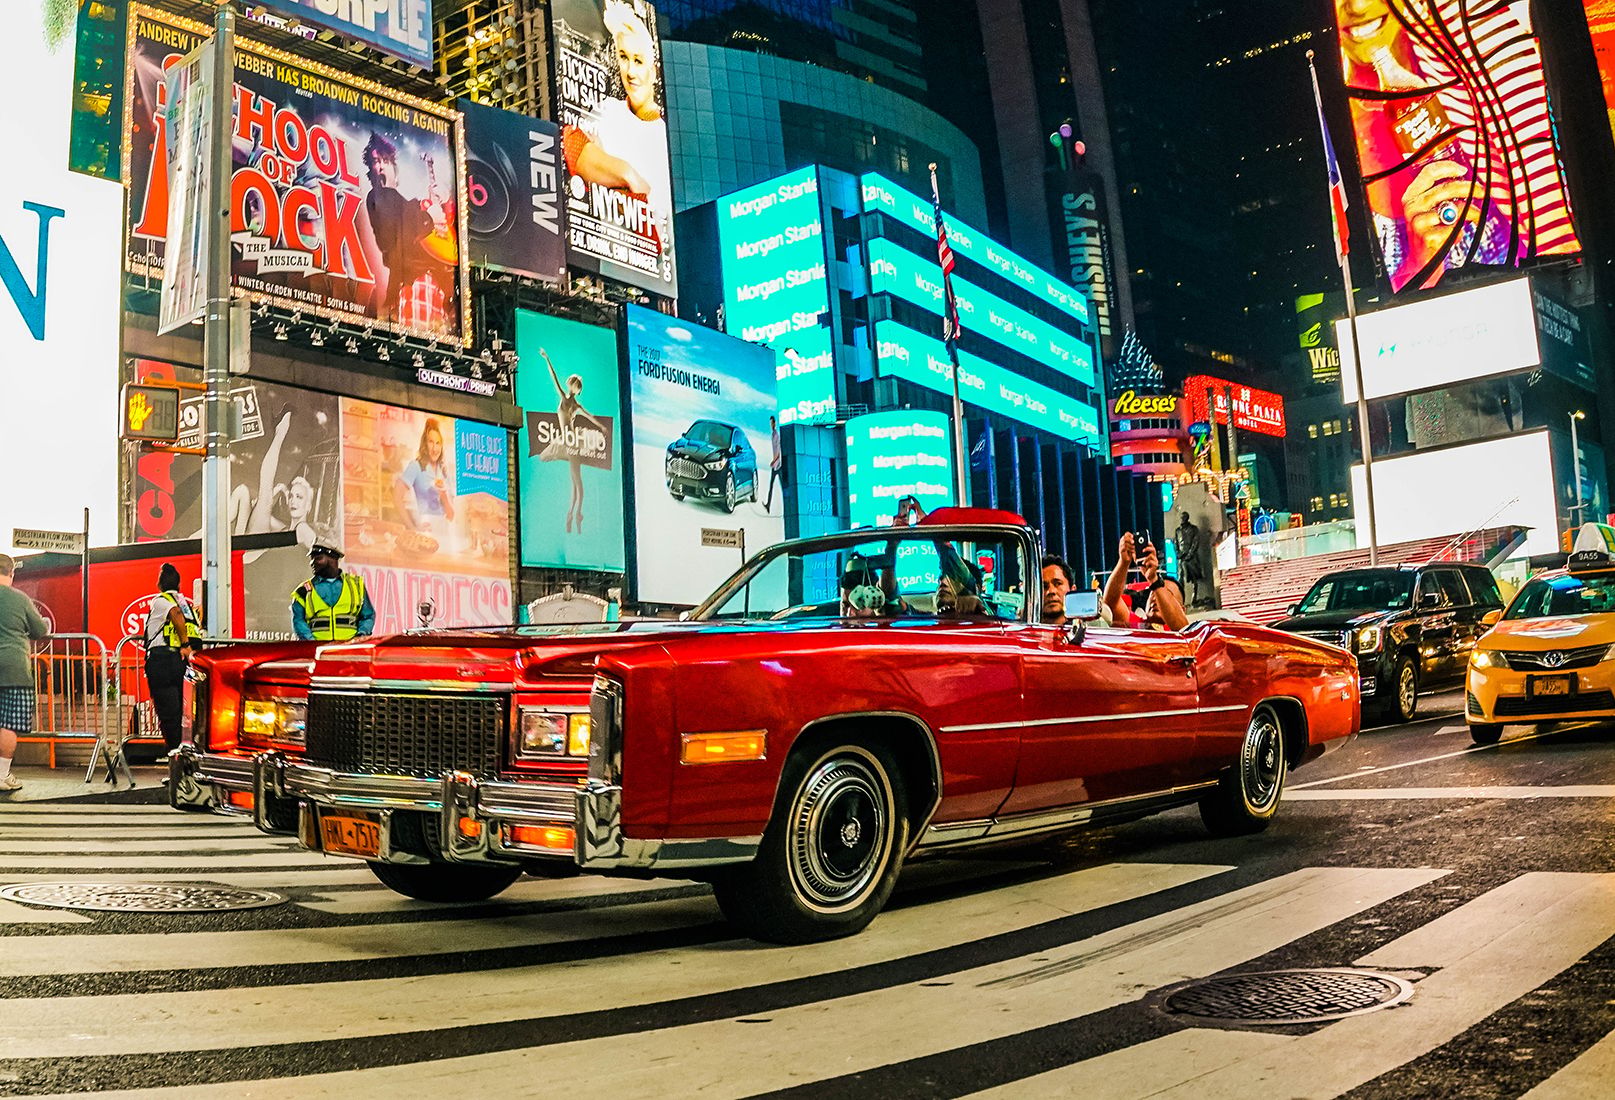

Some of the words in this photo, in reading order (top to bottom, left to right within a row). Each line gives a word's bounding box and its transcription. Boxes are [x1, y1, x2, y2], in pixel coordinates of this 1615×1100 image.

[138, 20, 188, 51] ANDREW
[560, 50, 606, 93] TICKETS
[277, 66, 300, 88] HAS
[302, 75, 360, 107] BROADWAY
[362, 95, 410, 124] ROCKING
[412, 112, 450, 136] AGAIN!
[562, 76, 579, 103] ON
[260, 152, 295, 187] OF
[528, 130, 559, 235] NEW
[730, 192, 777, 219] Morgan
[246, 243, 267, 253] THE
[736, 233, 784, 259] Morgan
[263, 255, 310, 267] MUSICAL
[238, 275, 265, 291] WINTER
[265, 283, 293, 298] GARDEN
[293, 288, 322, 305] THEATRE
[737, 277, 785, 302] Morgan
[742, 319, 791, 343] Morgan
[420, 370, 466, 391] OUTFRONT
[469, 381, 495, 396] PRIME
[638, 359, 661, 379] FORD
[661, 365, 691, 388] FUSION
[692, 373, 720, 396] ENERGI
[1114, 390, 1177, 414] Reese's
[1253, 404, 1282, 423] PLAZA
[537, 420, 606, 451] StubHub
[1238, 417, 1258, 429] HOTEL
[466, 432, 486, 453] LITTLE
[486, 436, 503, 455] SLICE
[465, 452, 474, 471] OF
[474, 453, 499, 474] HEAVEN
[1578, 552, 1599, 561] 9A55
